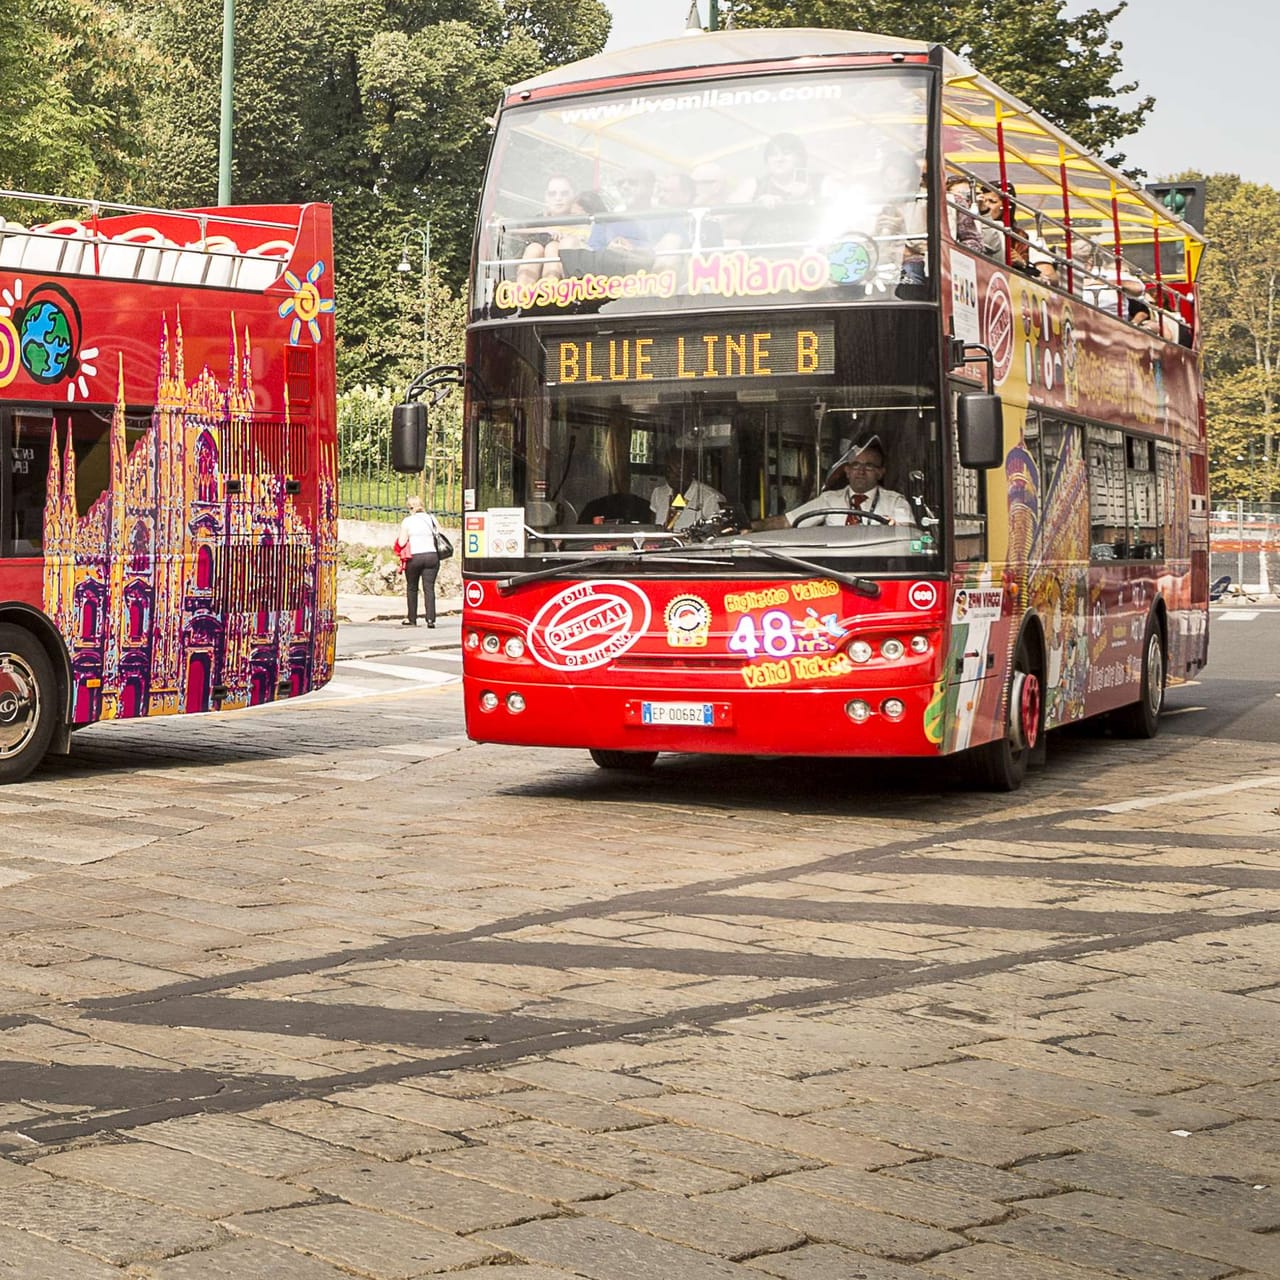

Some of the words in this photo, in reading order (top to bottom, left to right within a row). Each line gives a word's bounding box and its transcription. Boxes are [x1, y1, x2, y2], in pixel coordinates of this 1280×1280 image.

[560, 85, 841, 124] www.livemilano.com
[497, 271, 675, 309] CitySightseeing
[688, 252, 829, 297] Milano
[560, 339, 654, 383] BLUE
[678, 333, 772, 378] LINE
[796, 331, 819, 374] B
[468, 534, 479, 553] B
[556, 586, 596, 609] TOUR
[724, 589, 789, 613] Biglietto
[792, 580, 840, 601] Valido
[549, 603, 628, 646] OFFICIAL
[727, 609, 796, 659] 48
[566, 656, 585, 666] OF
[587, 631, 634, 663] MILANO
[741, 663, 791, 689] Valid
[794, 653, 853, 680] Ticket
[653, 707, 666, 721] EP
